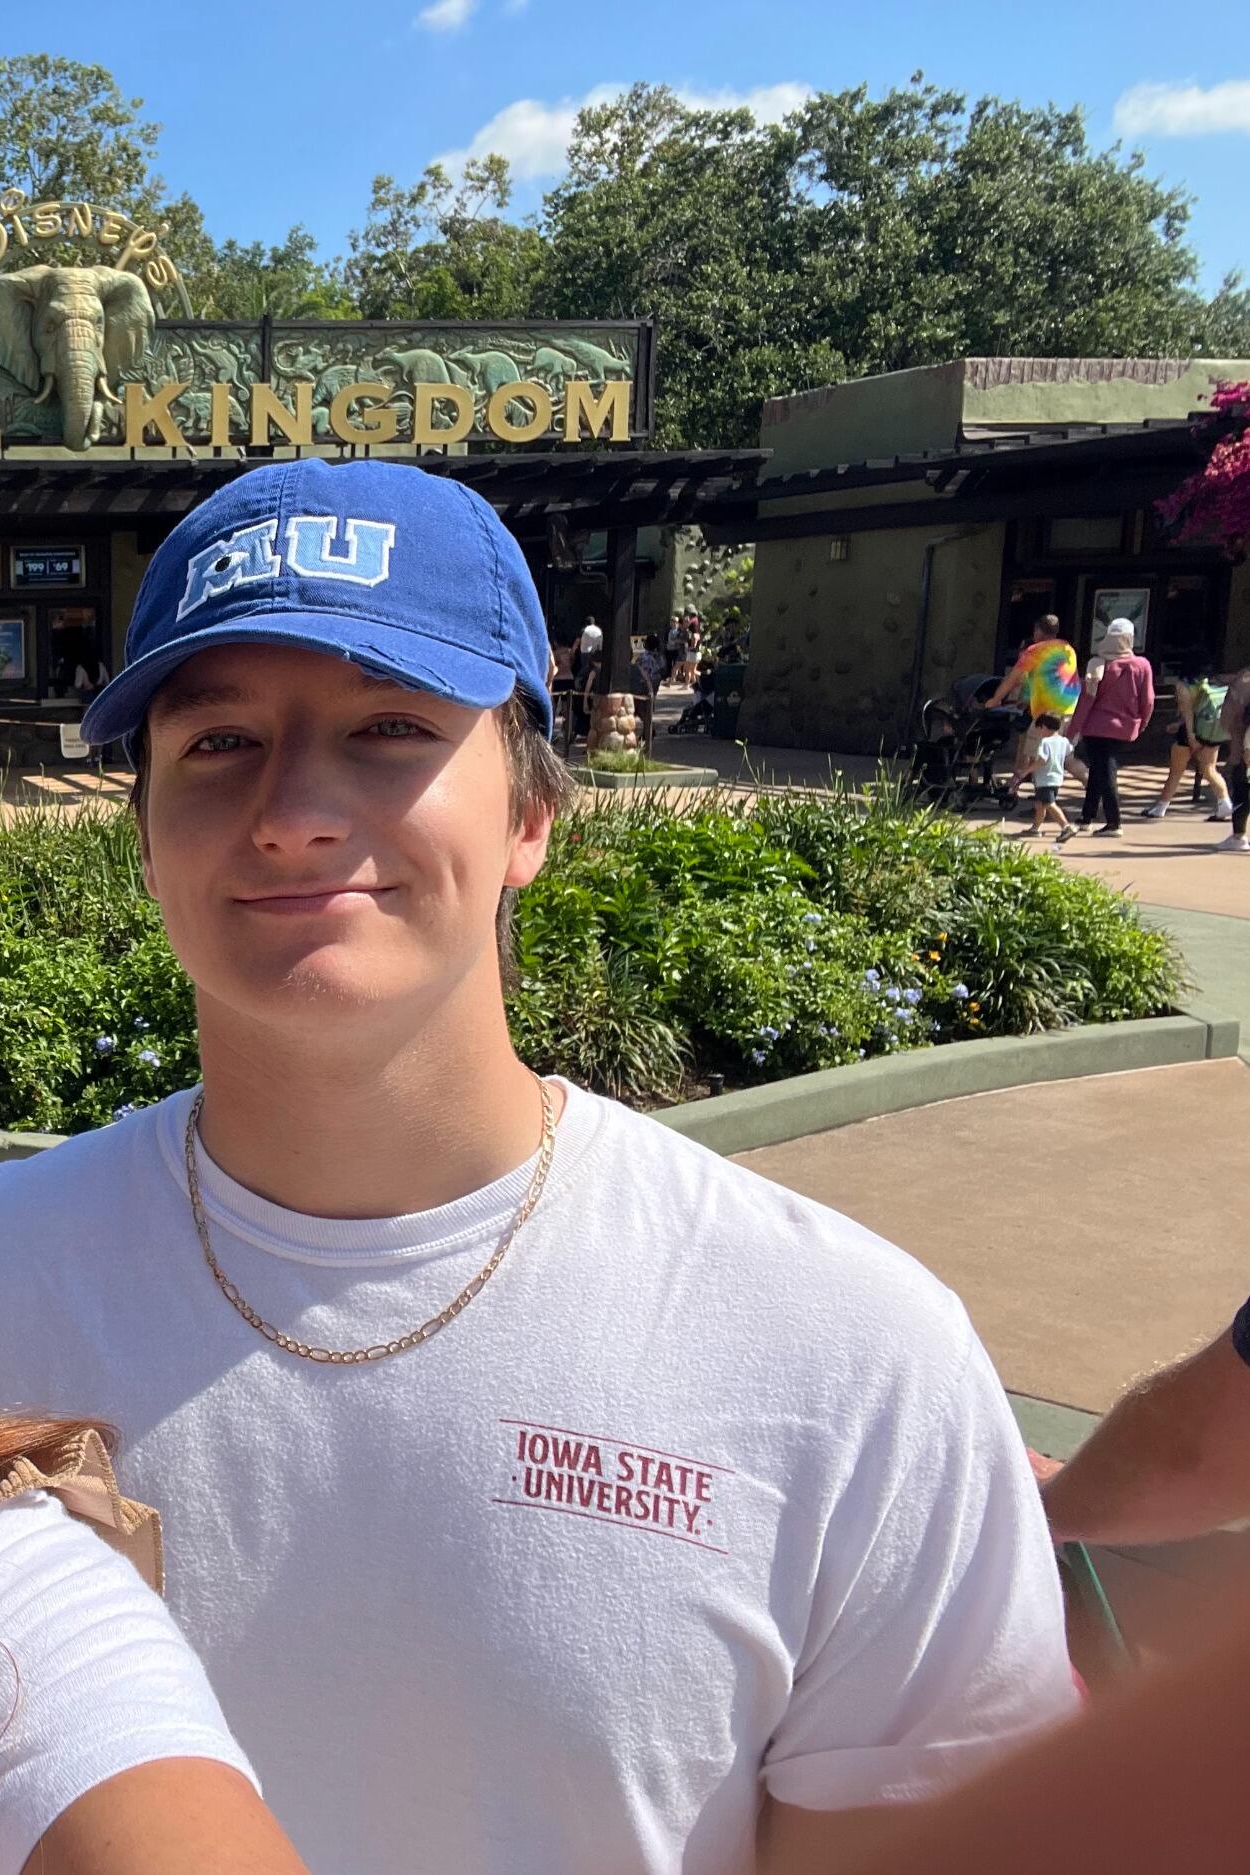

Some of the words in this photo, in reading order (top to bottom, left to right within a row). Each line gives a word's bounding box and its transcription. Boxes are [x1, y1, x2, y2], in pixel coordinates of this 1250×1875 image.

[123, 380, 633, 447] KINGDOM
[517, 1431, 603, 1477] IOWA
[616, 1452, 713, 1503] STATE
